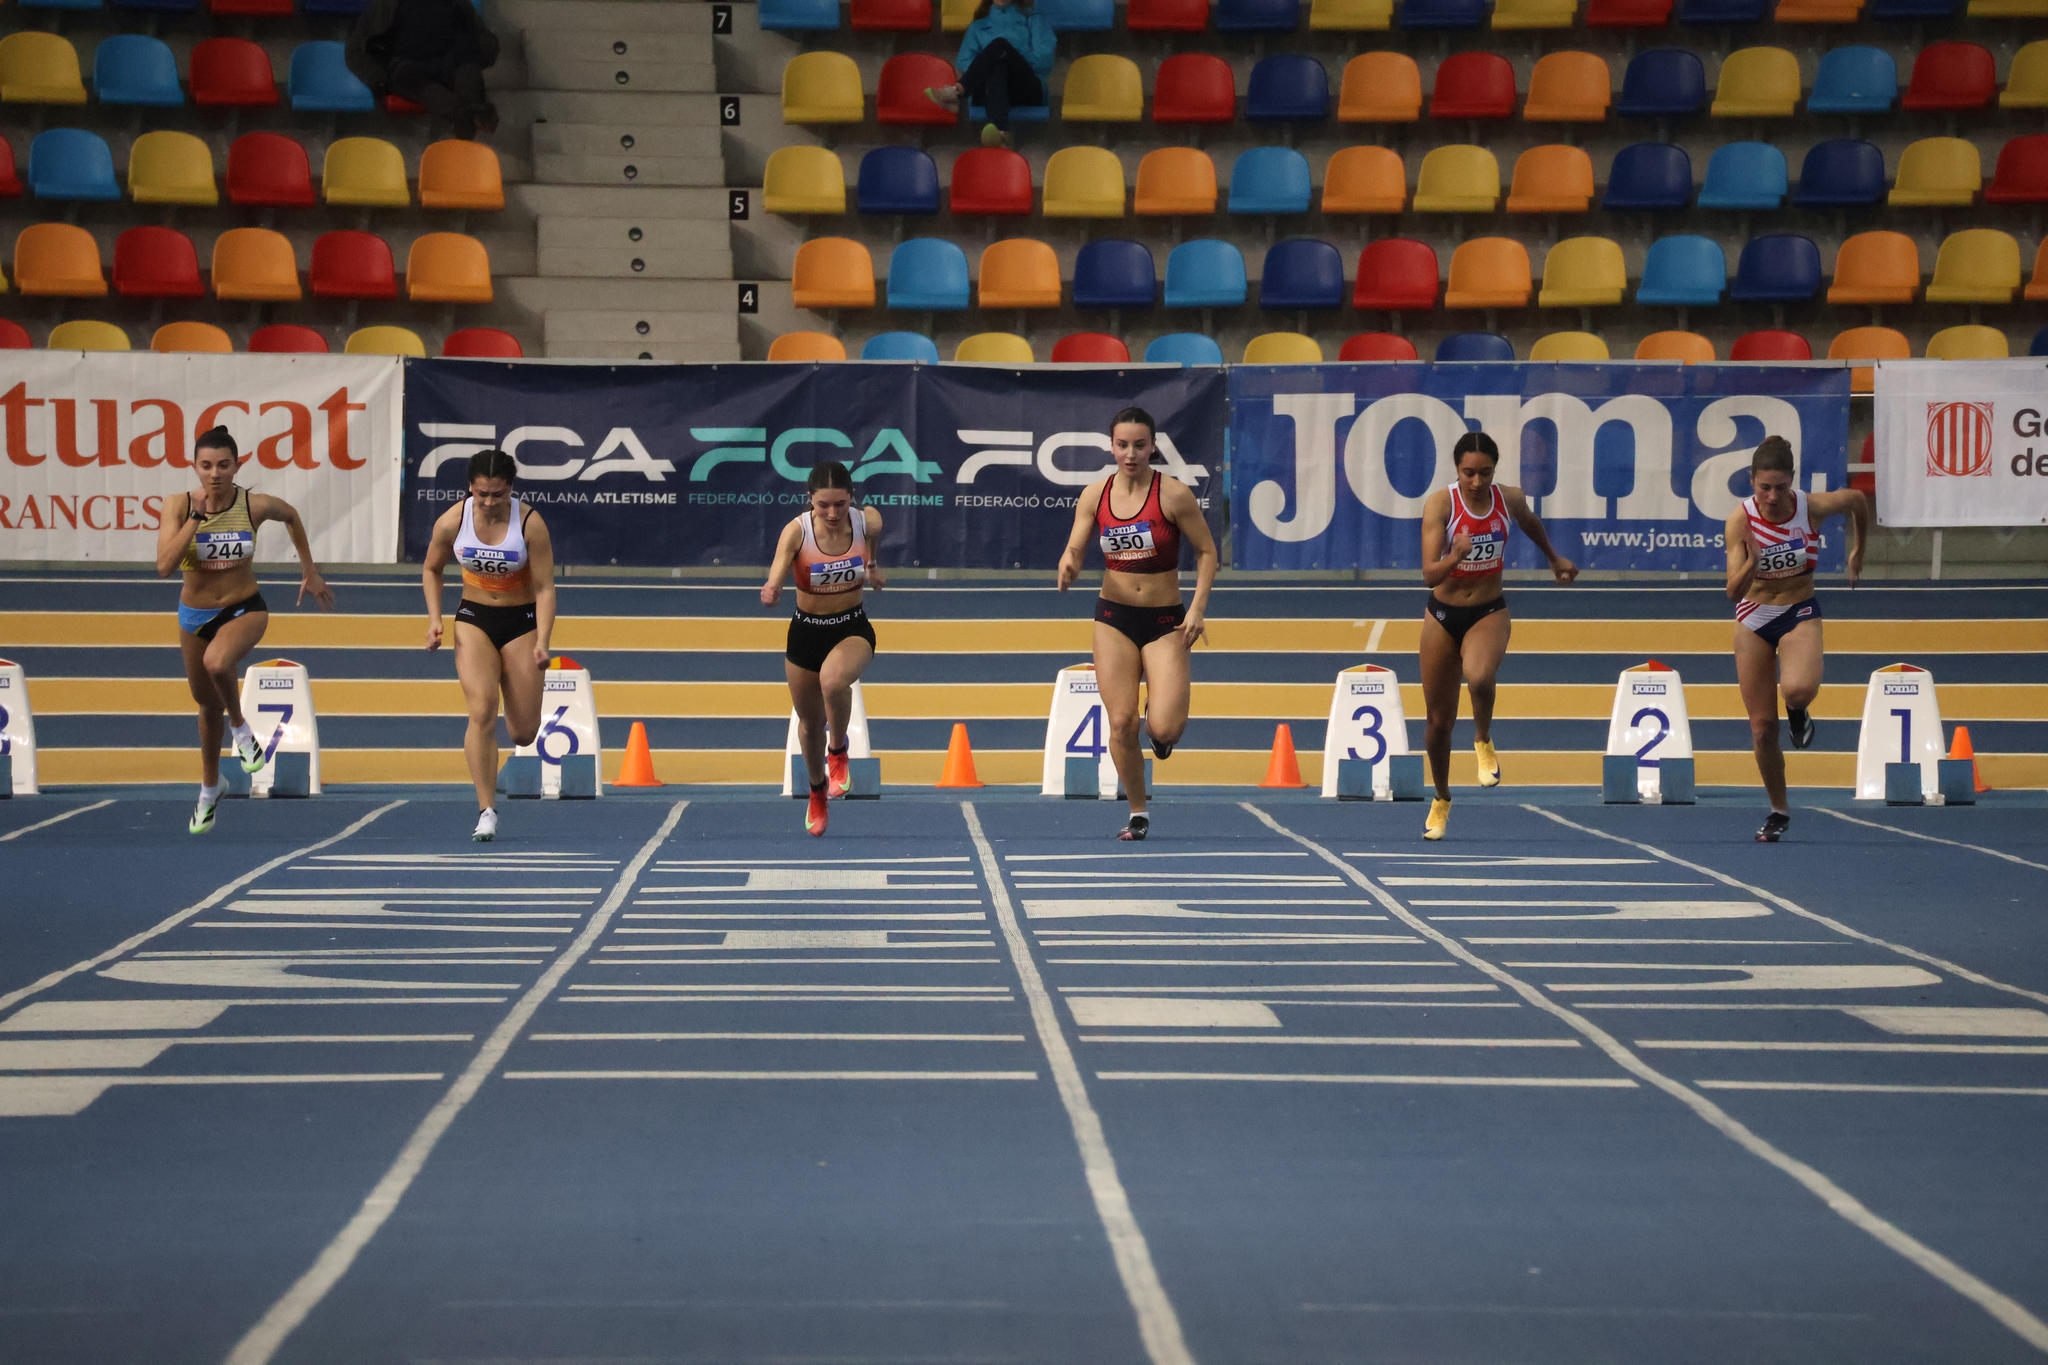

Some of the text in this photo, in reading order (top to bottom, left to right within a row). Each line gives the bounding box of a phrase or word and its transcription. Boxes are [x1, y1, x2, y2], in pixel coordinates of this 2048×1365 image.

[717, 13, 727, 28] 7
[724, 103, 736, 119] 6
[733, 198, 744, 213] 5
[742, 291, 753, 307] 4
[2013, 408, 2048, 438] G
[418, 422, 677, 481] FCA
[690, 427, 943, 483] FCA
[417, 489, 467, 501] FEDER
[593, 492, 677, 504] ATLETISME
[688, 492, 773, 505] FEDERACIÓ
[861, 494, 944, 507] ATLETISME
[955, 494, 1079, 508] FEDERACIÓ CATA
[1108, 534, 1144, 552] 350
[1470, 533, 1493, 544] oma
[206, 543, 244, 560] 244
[1108, 549, 1154, 561] mutuacat
[472, 559, 509, 574] 366
[1760, 552, 1798, 571] 368
[820, 569, 856, 586] 270
[803, 613, 851, 625] ARMOUR
[258, 704, 294, 763] 7
[536, 706, 579, 765] 6
[1066, 705, 1107, 762] 4
[1347, 706, 1387, 765] 3
[1631, 707, 1670, 767] 2
[1891, 709, 1911, 762] 1
